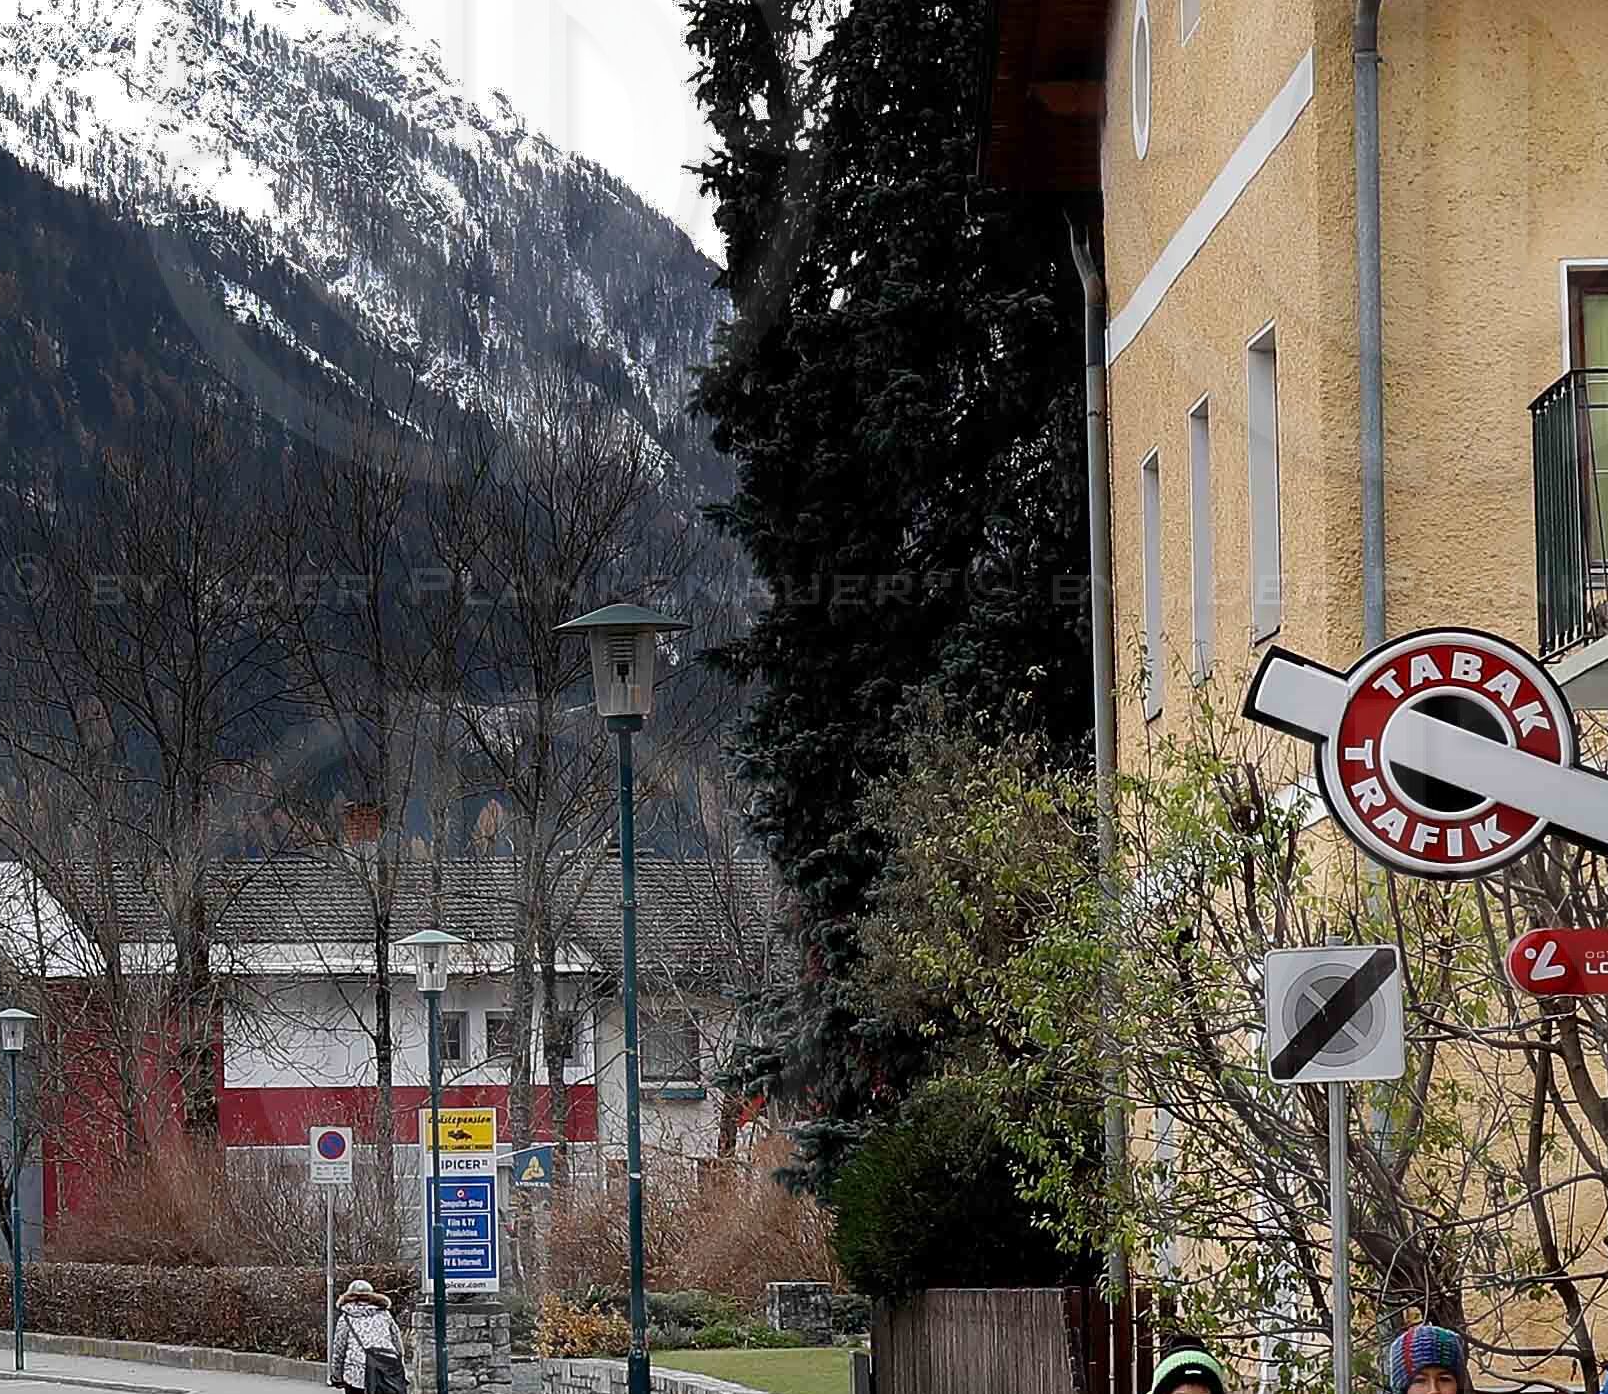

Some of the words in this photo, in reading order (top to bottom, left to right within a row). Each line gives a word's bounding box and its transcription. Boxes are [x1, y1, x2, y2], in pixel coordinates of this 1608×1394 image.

[1372, 652, 1550, 737] TABAK
[1345, 739, 1511, 857] TRAFIK
[441, 1159, 481, 1170] IPICER
